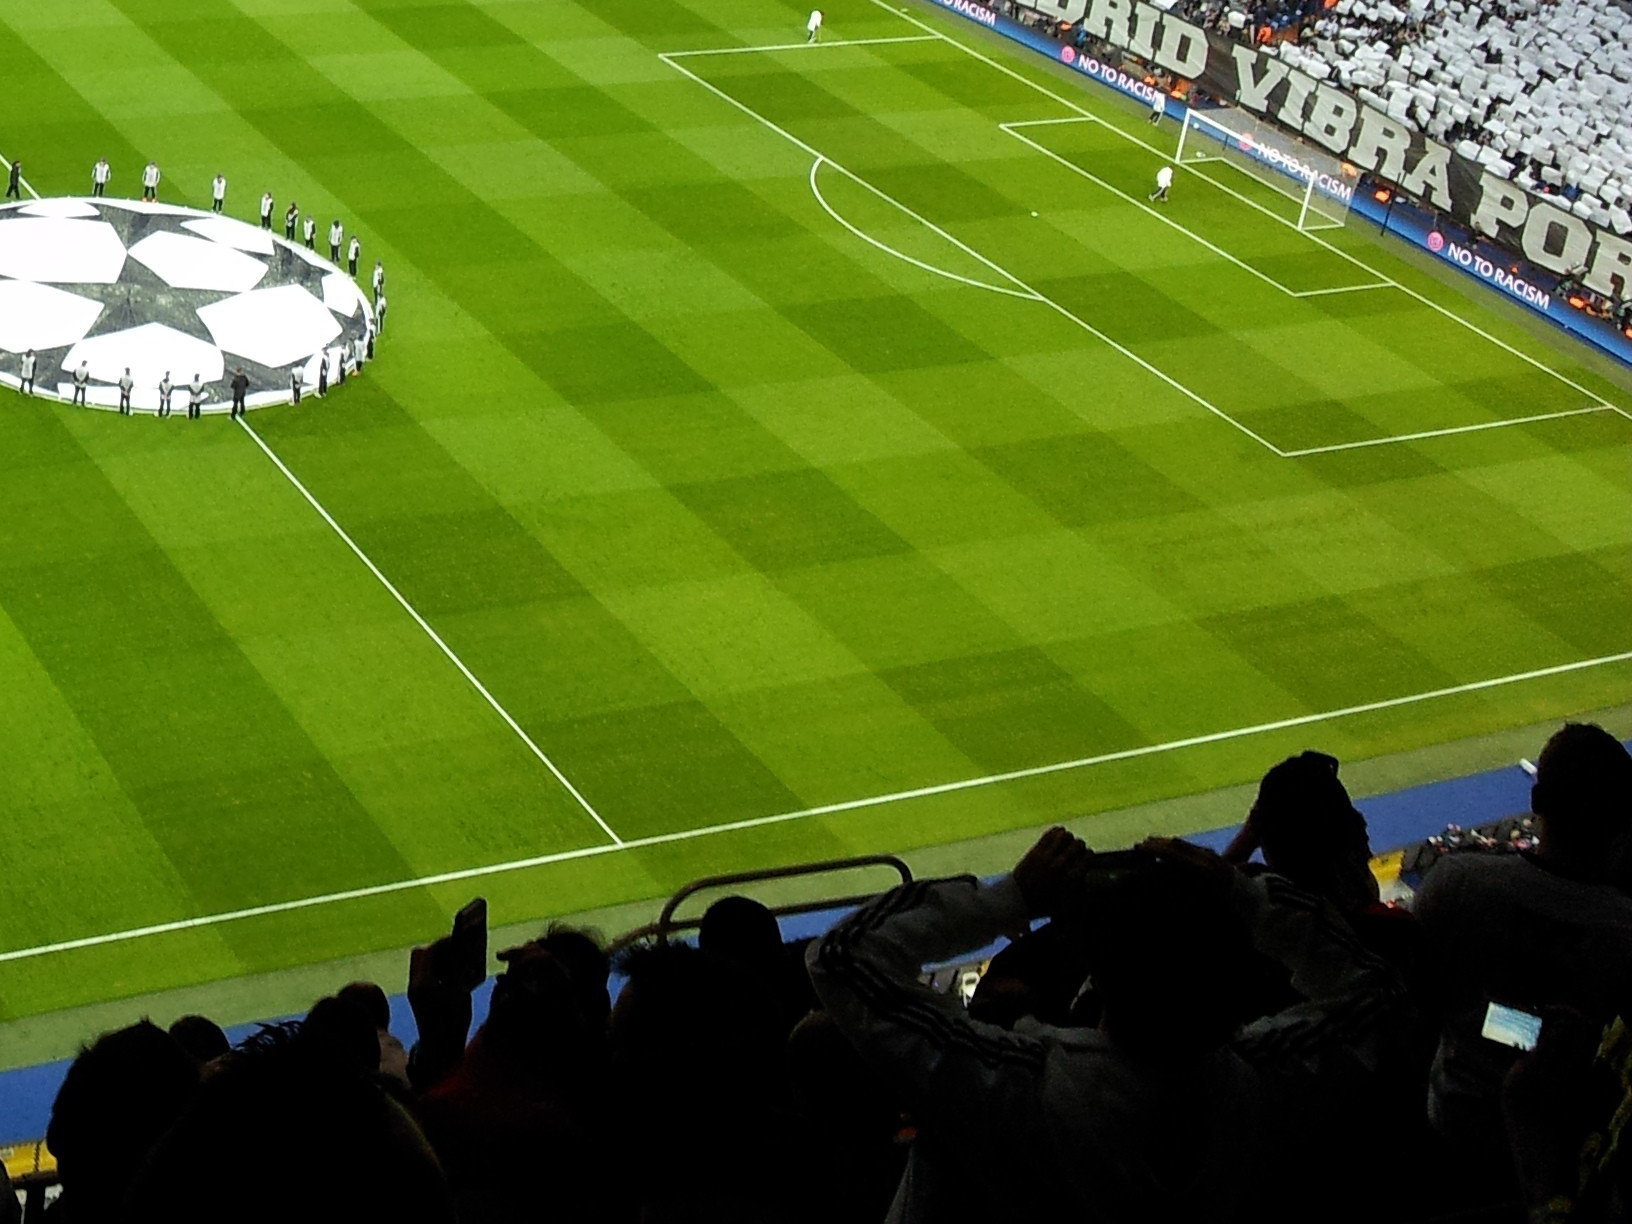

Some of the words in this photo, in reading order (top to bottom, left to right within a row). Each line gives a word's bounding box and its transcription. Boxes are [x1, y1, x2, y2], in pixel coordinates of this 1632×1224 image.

[1078, 54, 1099, 74] NO
[1100, 64, 1117, 83] TO
[1232, 44, 1453, 212] VIBRA
[1470, 172, 1632, 301] POR
[1258, 142, 1280, 162] NO
[1282, 153, 1300, 172] TO
[1300, 165, 1352, 200] RACISM
[1447, 242, 1472, 266] NO
[1474, 255, 1494, 277] TO
[1494, 267, 1550, 310] RACISM
